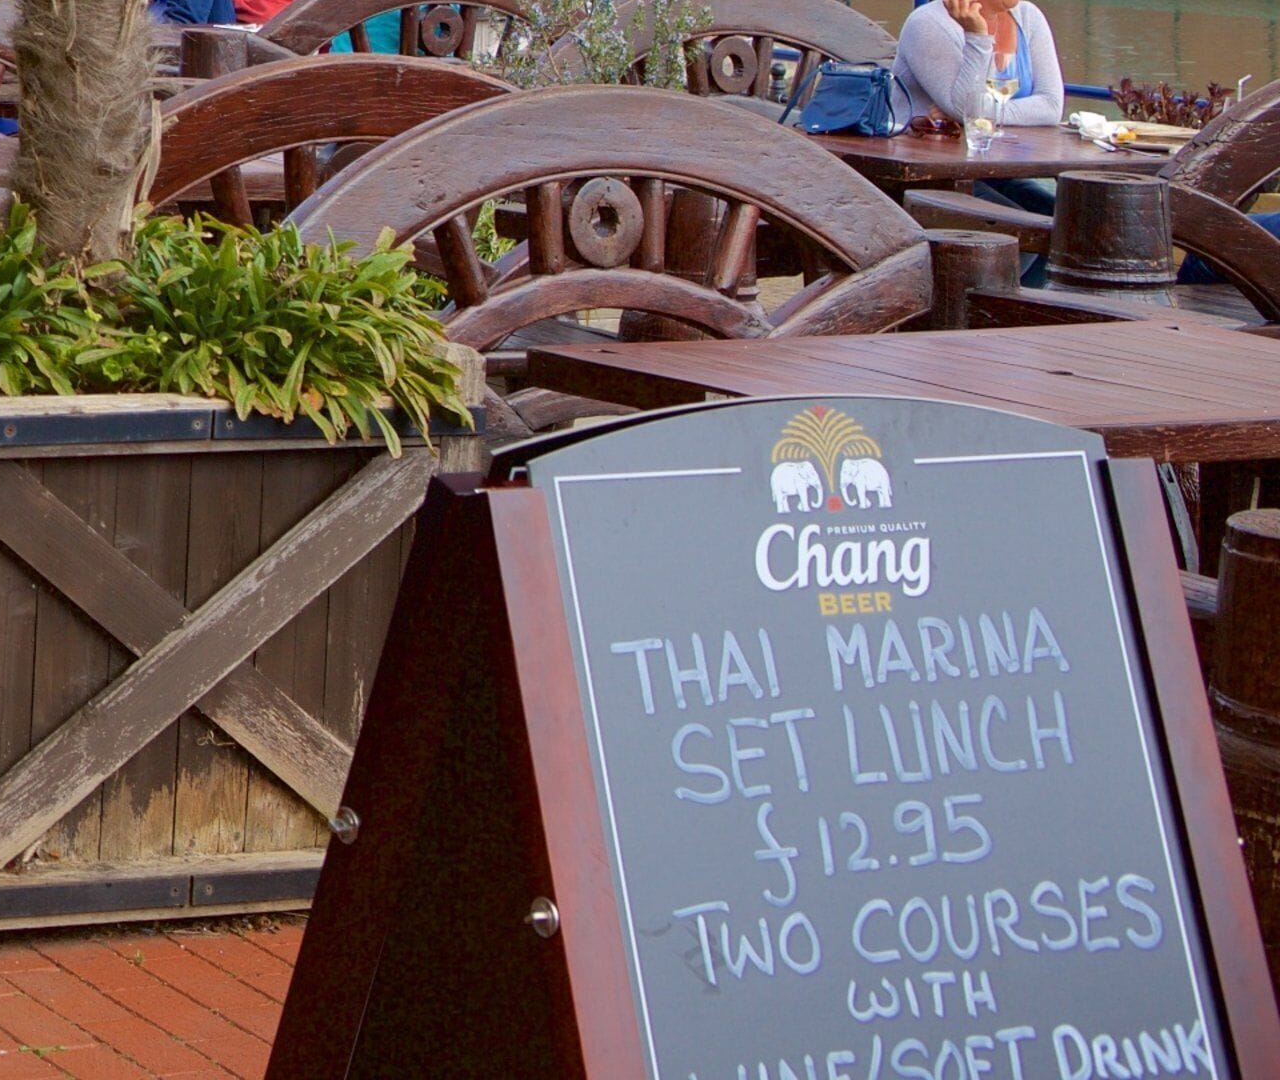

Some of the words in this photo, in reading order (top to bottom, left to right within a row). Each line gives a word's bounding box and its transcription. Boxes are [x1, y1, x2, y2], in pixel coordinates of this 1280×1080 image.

[755, 523, 930, 597] Chang
[827, 525, 876, 535] PREMIUM
[880, 522, 927, 533] QUALITY
[819, 591, 892, 616] BEER
[610, 628, 781, 715] THAI
[826, 606, 1070, 691] MARINA
[671, 707, 816, 804] SET
[842, 689, 1074, 784] LUNCH
[671, 900, 822, 986] TWO
[851, 873, 1163, 963] COURSES
[847, 969, 997, 1021] WITH
[1051, 1018, 1212, 1080] DRINK
